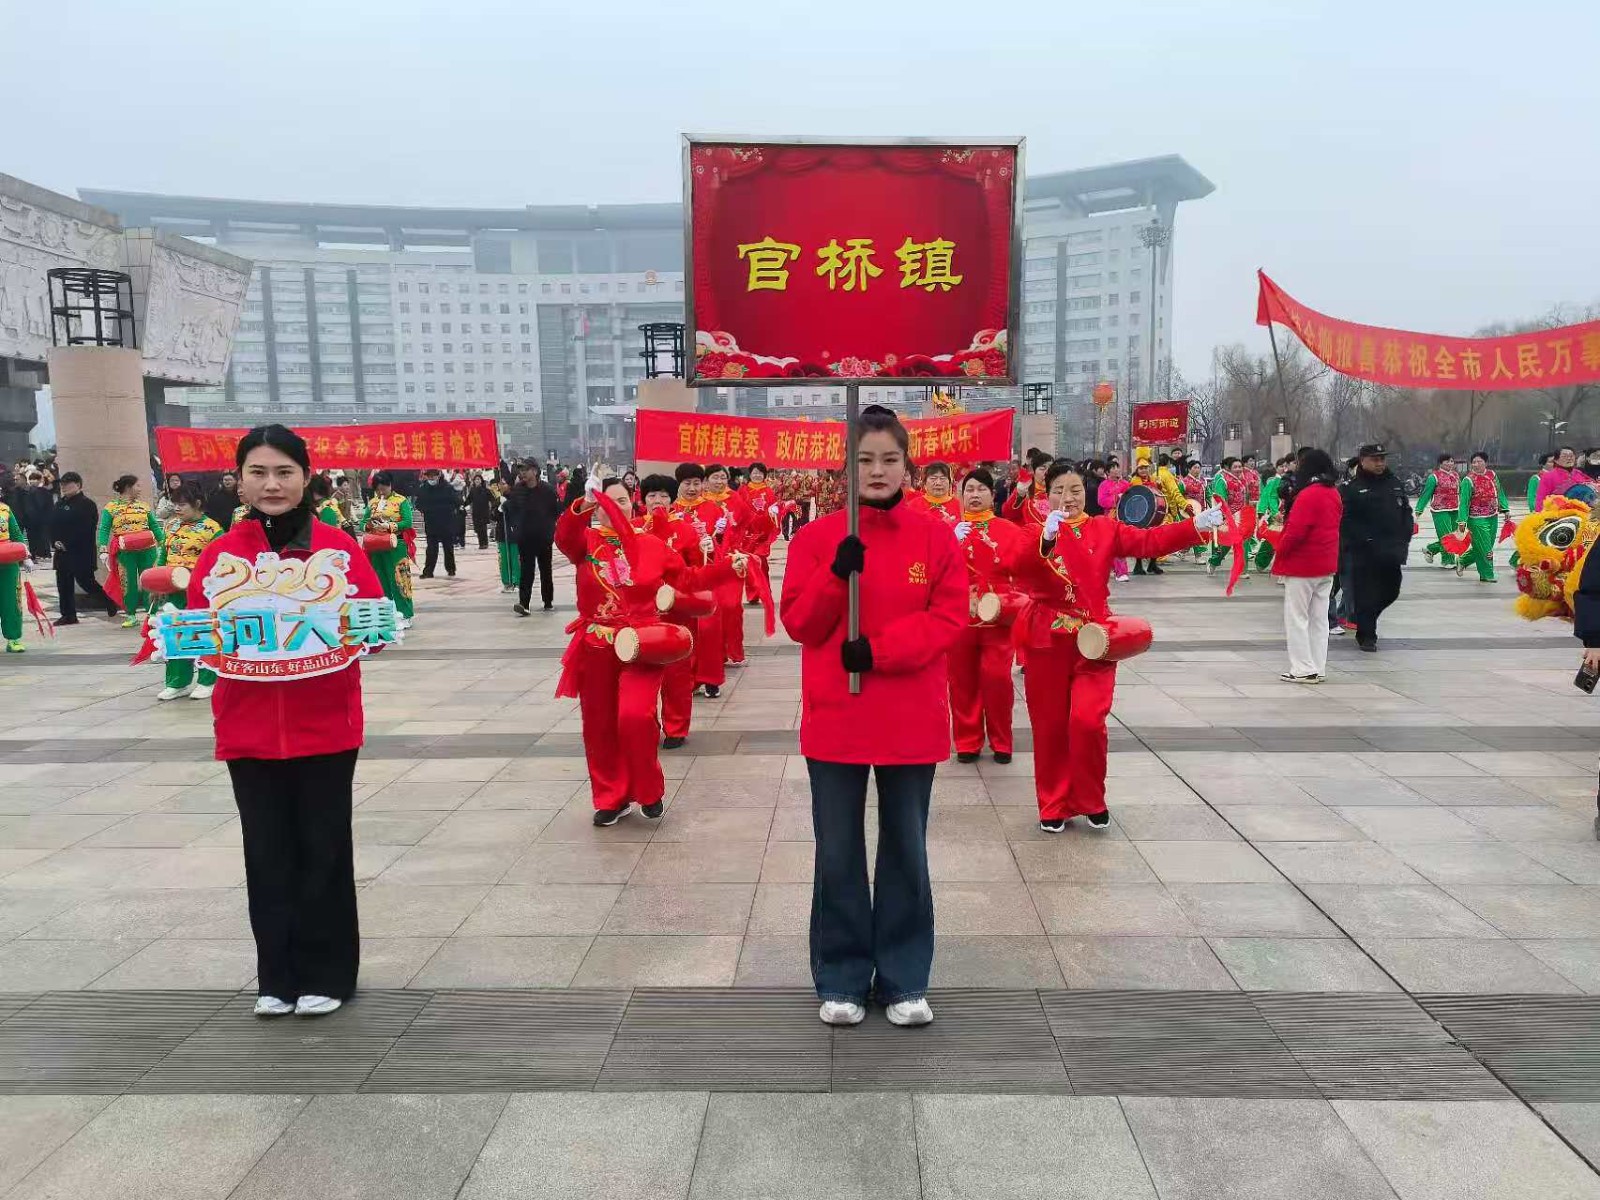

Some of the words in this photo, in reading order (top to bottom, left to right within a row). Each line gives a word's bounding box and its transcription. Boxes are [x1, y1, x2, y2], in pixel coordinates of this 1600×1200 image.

[737, 236, 963, 292] 官桥镇
[304, 428, 485, 462] 祝全市人民新春愉快
[679, 422, 848, 461] 官桥镇党委、政府恭祝
[212, 550, 344, 608] 2026
[160, 600, 397, 657] 运河大集
[225, 660, 284, 675] 好客山东
[288, 651, 344, 673] 好品山东
